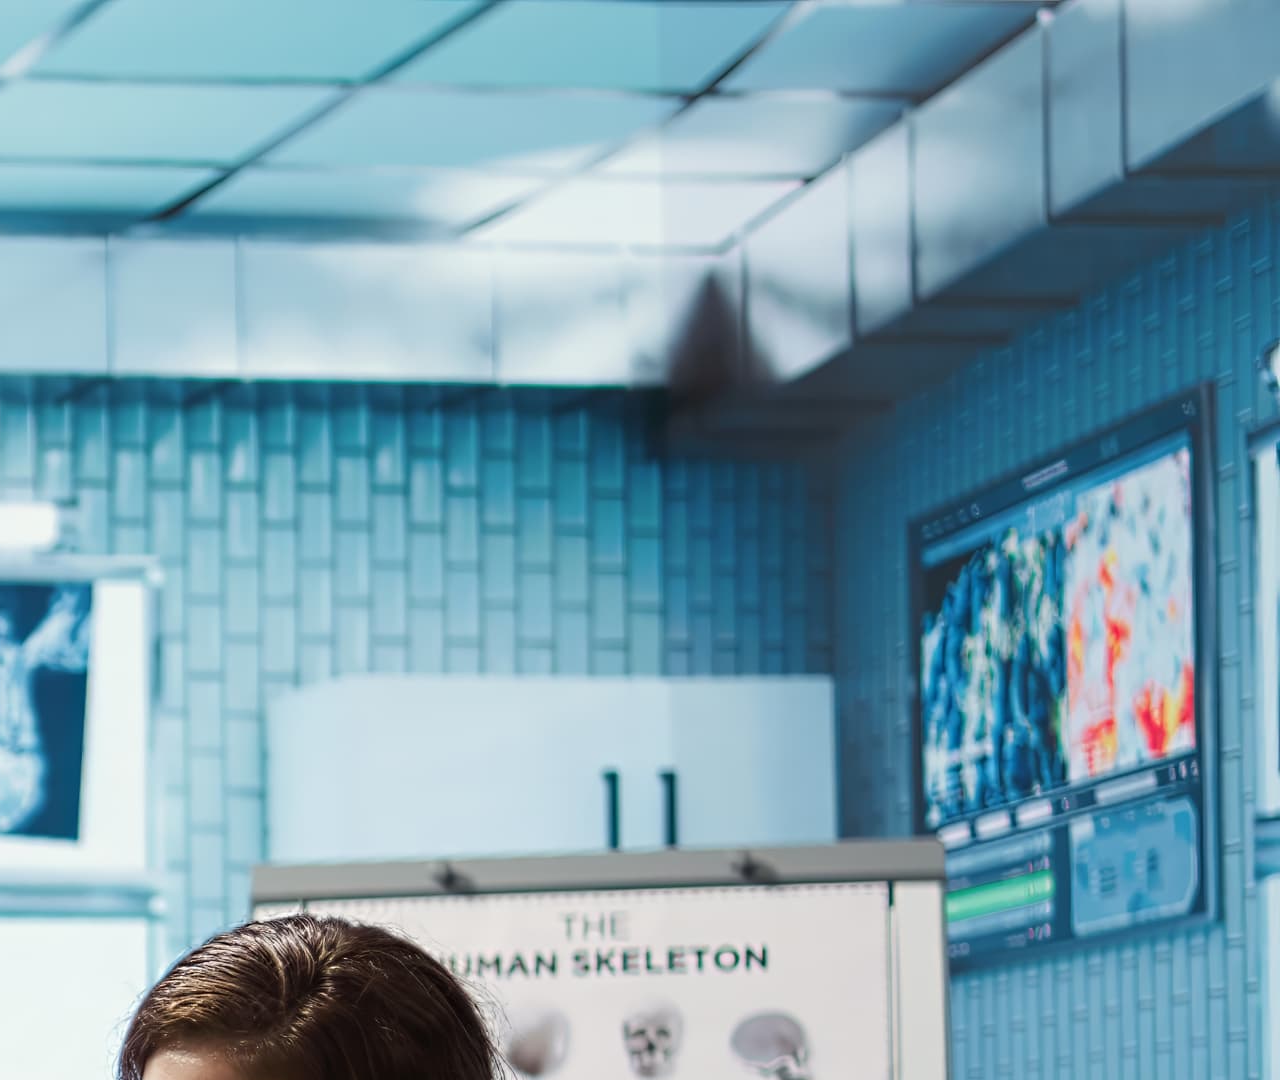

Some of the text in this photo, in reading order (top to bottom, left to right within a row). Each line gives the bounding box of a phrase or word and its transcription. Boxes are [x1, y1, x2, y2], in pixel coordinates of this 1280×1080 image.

[560, 911, 630, 941] THE
[440, 944, 768, 978] UMAN SKELETON
